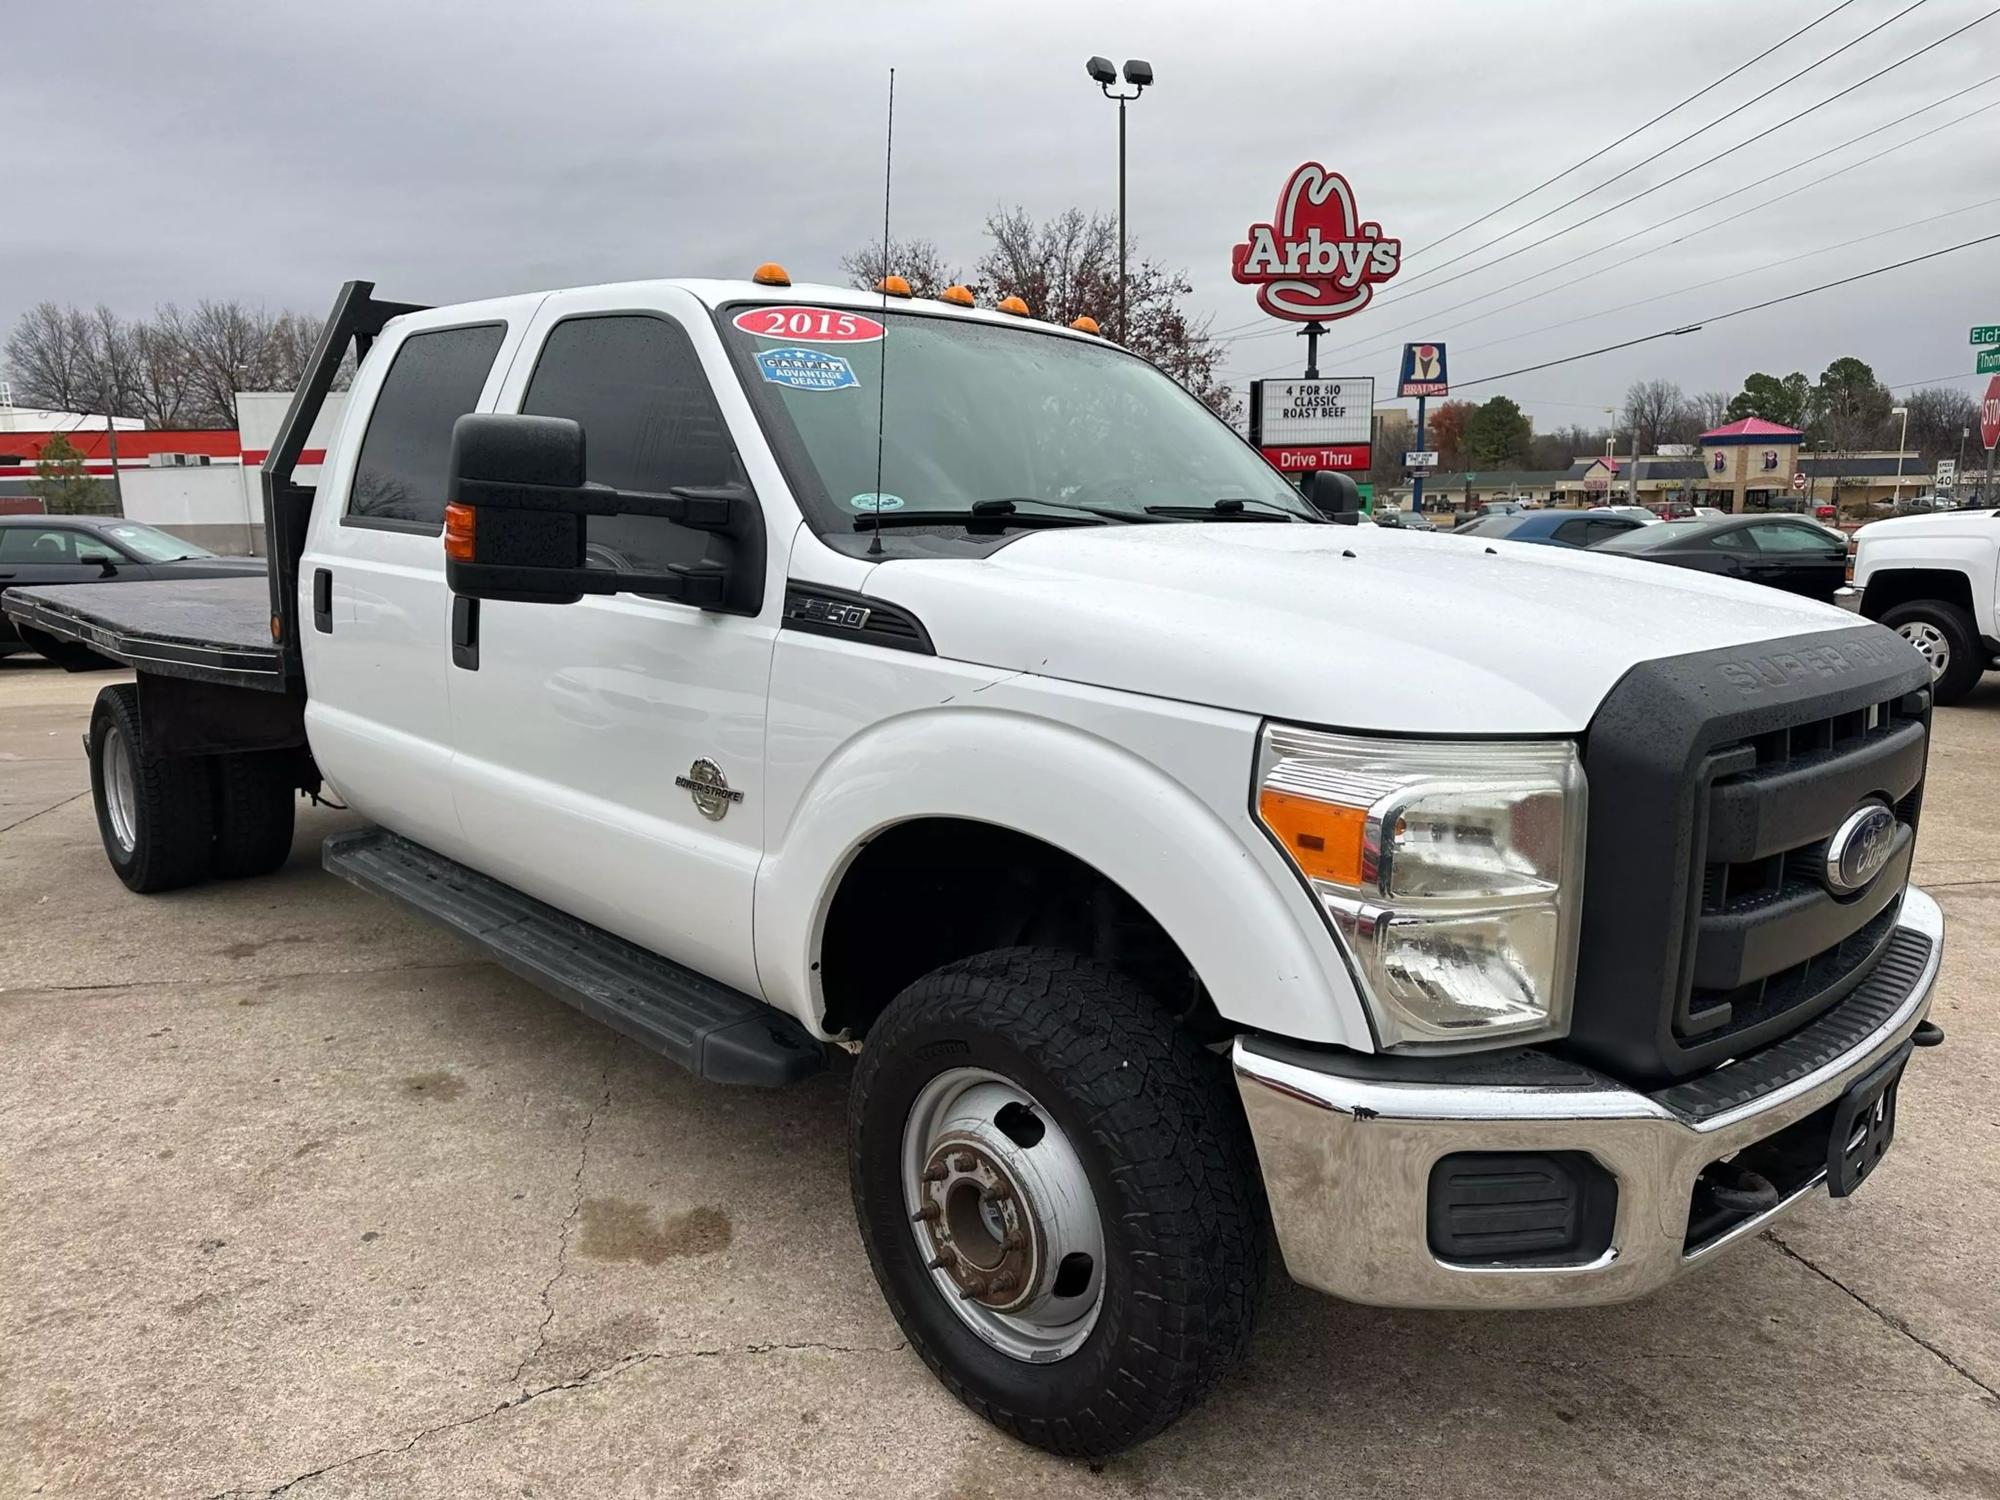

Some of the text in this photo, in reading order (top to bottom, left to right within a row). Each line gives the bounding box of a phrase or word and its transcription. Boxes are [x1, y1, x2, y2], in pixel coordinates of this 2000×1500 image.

[1244, 226, 1398, 288] Arby's
[764, 313, 857, 336] 2015
[766, 359, 846, 372] CARFAX
[776, 368, 844, 380] ADVANTAGE
[790, 377, 836, 387] DEALER
[1286, 384, 1341, 396] 4 FOR $10
[1294, 396, 1337, 407] CLASSIC
[1283, 407, 1346, 418] ROAST BEEF
[1983, 398, 2000, 425] STO
[1280, 450, 1352, 467] Drive Thru
[1936, 475, 1951, 486] 40
[1715, 646, 1857, 695] SUPER
[675, 776, 741, 802] POWER STROKE
[1856, 818, 1892, 875] Ford
